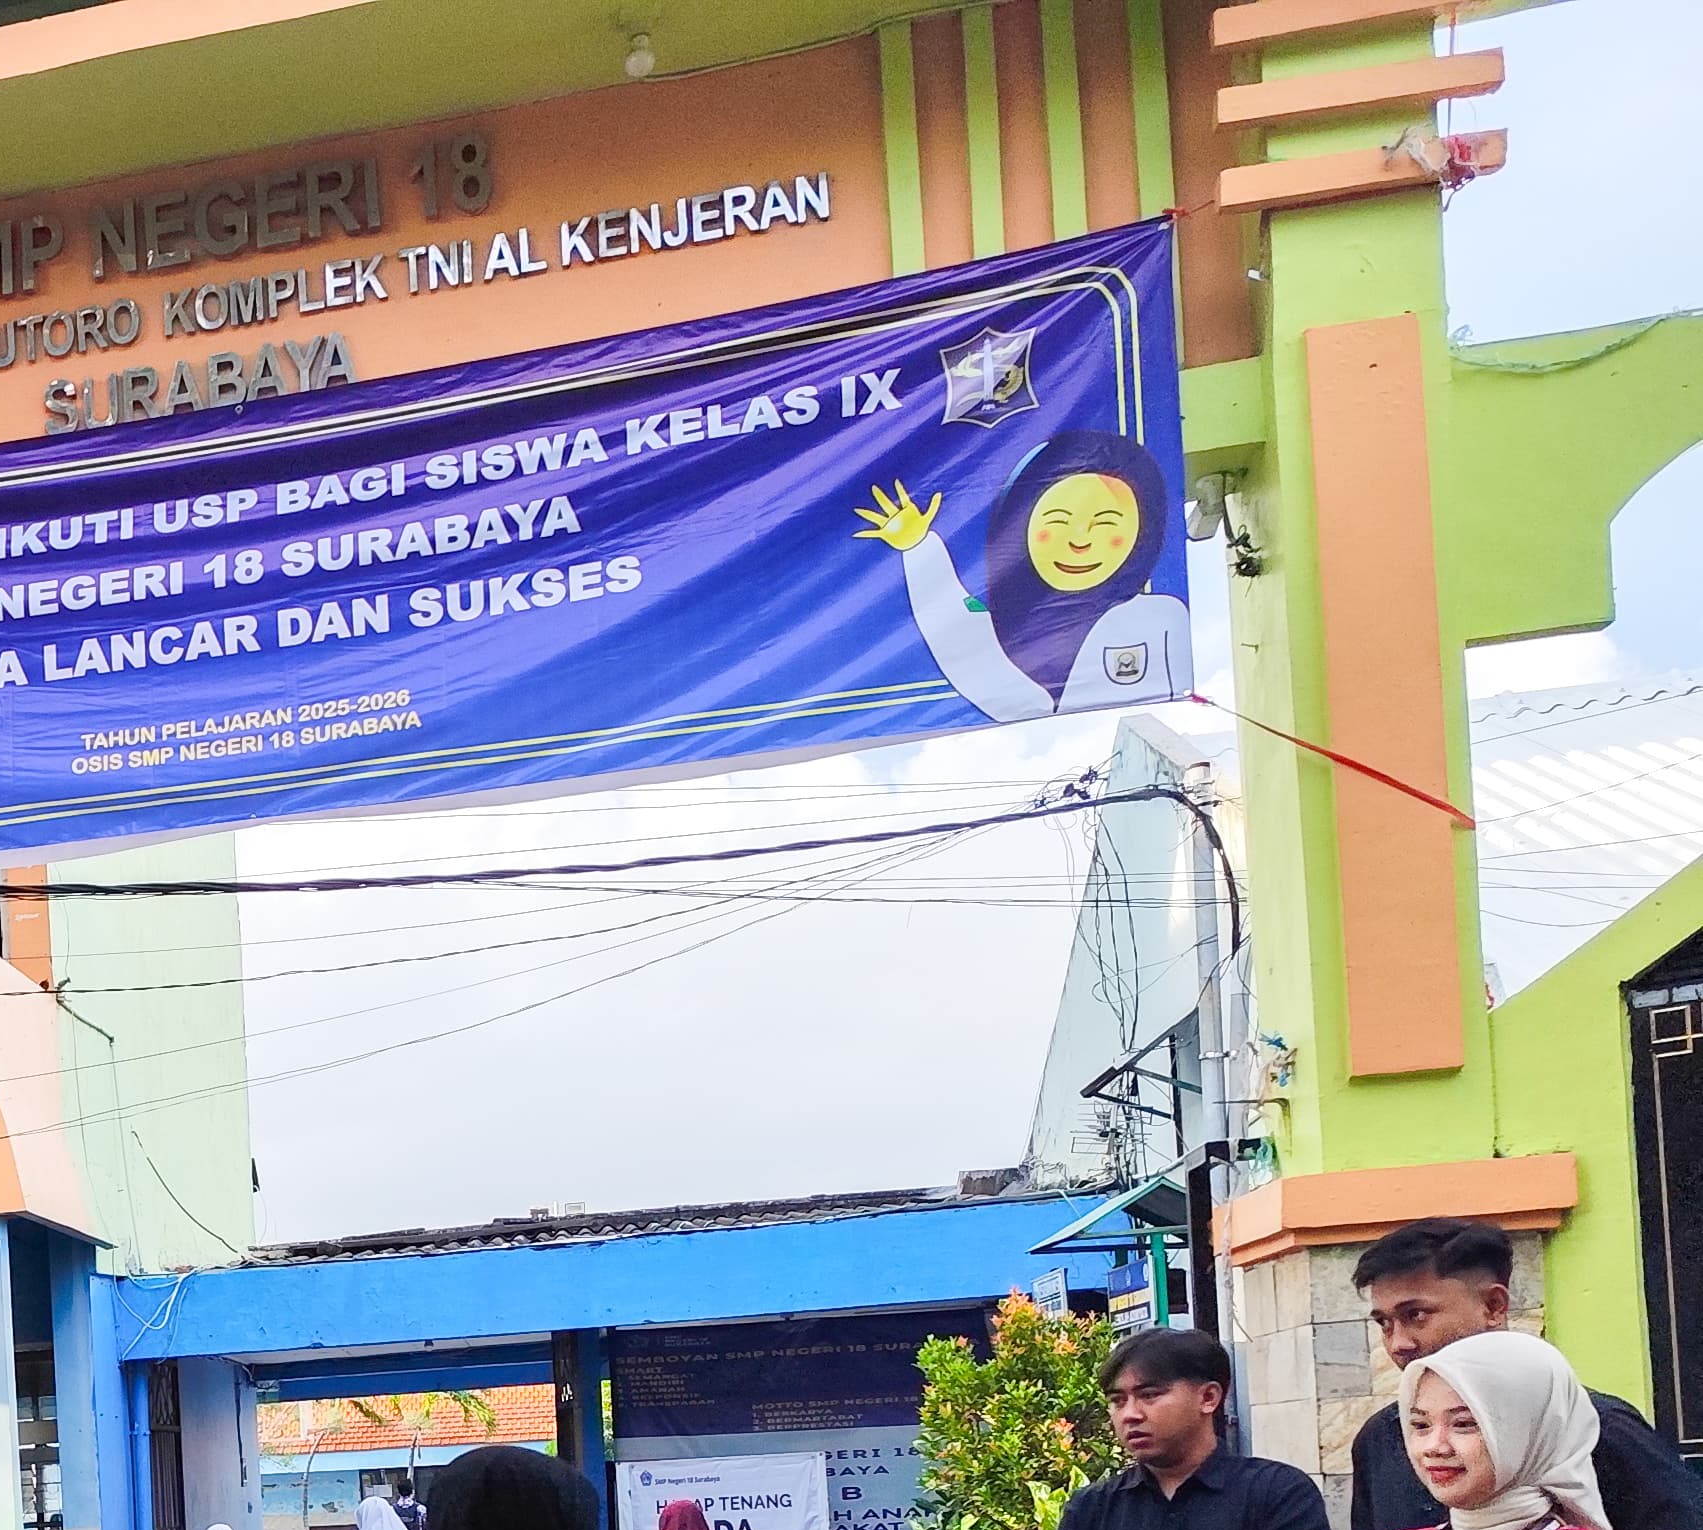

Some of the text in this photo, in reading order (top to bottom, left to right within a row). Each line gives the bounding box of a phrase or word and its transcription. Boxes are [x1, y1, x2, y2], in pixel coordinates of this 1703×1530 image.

[95, 158, 380, 280] NEGERI
[412, 138, 492, 217] 18
[163, 260, 387, 334] KOMPLEK
[400, 241, 472, 292] TNI
[486, 229, 547, 281] AL
[560, 173, 831, 269] KENJERAN
[44, 333, 356, 435] SURABAYA
[153, 489, 258, 534] USP
[275, 463, 406, 515] BAGI
[425, 429, 607, 489] SISWA
[626, 384, 820, 455] KELAS
[842, 368, 903, 417] IX
[203, 554, 265, 588] 18
[281, 496, 582, 577] SURABAYA
[43, 615, 260, 682] LANCAR
[277, 595, 390, 648] DAN
[408, 555, 642, 629] SUKSES
[71, 710, 422, 775] OSIS SMP NEGERI 18 SURABAYA
[82, 689, 411, 751] TAHUN PELAJARAN 2025-2026
[657, 1494, 792, 1514] HAP TENANG
[841, 1486, 862, 1500] B
